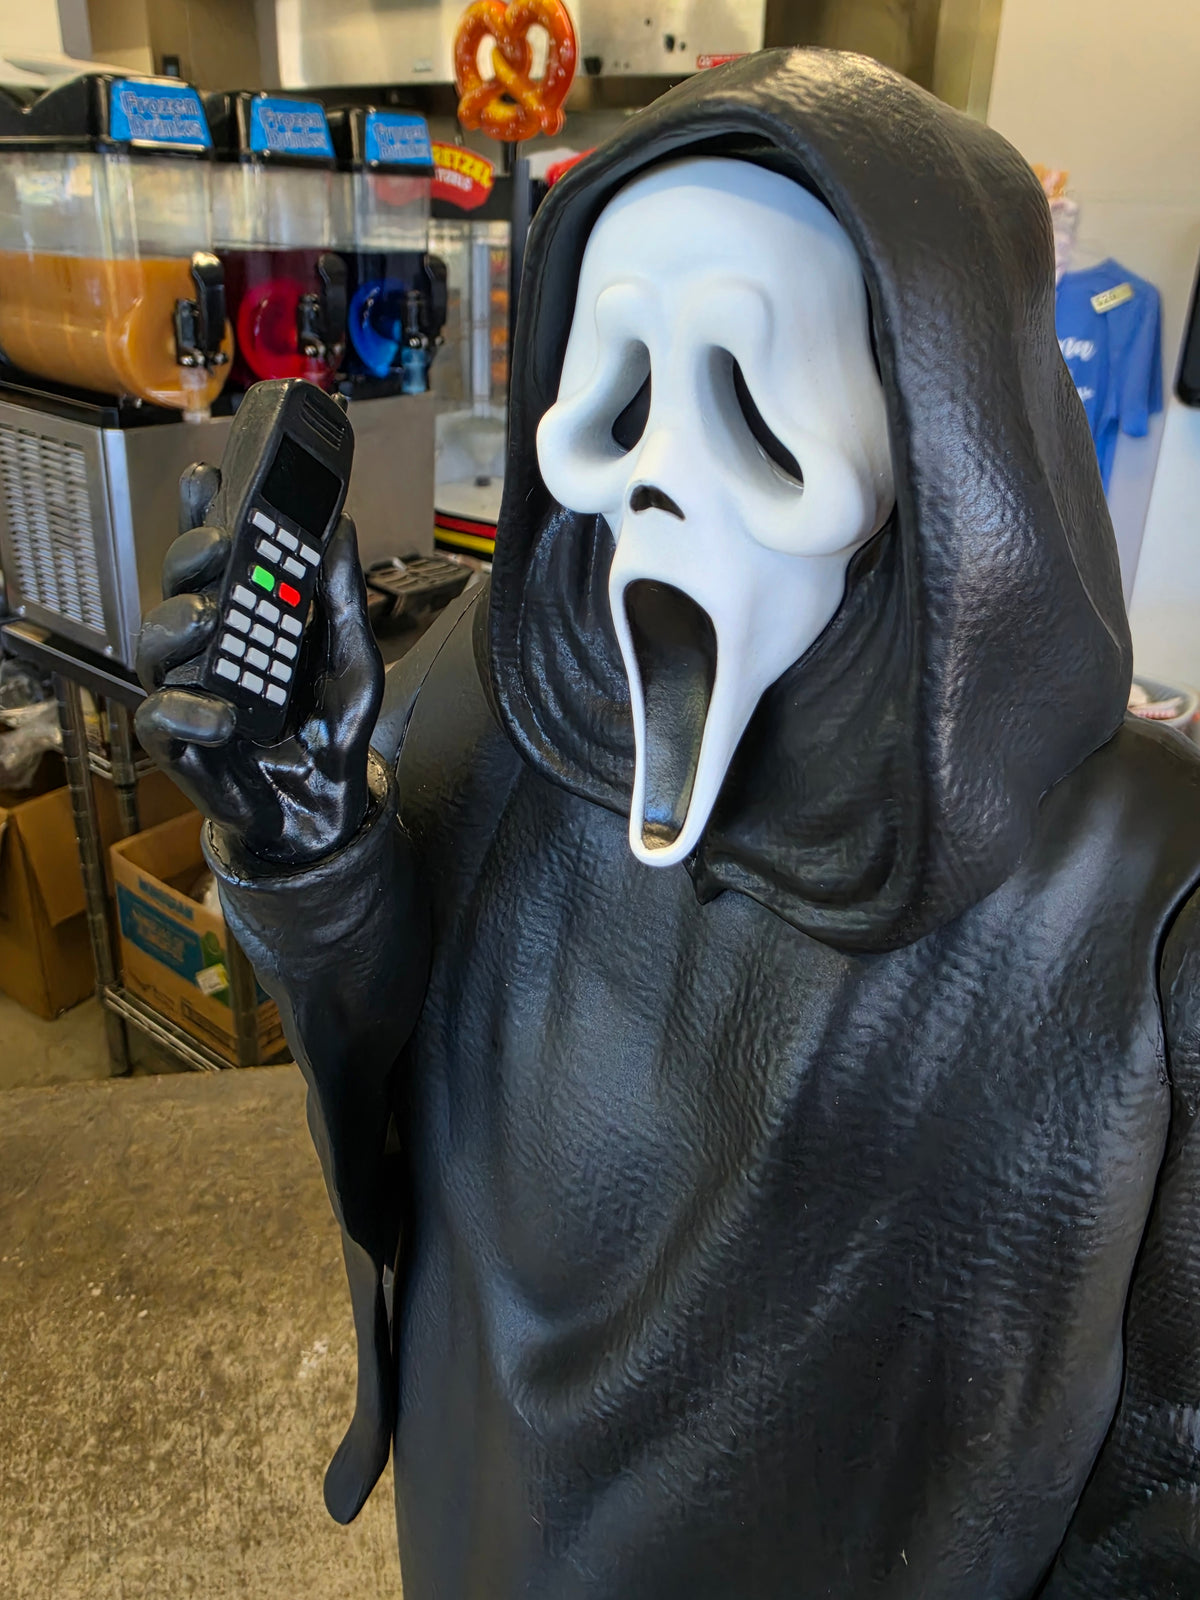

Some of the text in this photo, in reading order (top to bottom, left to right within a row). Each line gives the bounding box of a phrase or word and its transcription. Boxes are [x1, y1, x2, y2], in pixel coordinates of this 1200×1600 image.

[120, 89, 199, 115] Frozen
[258, 107, 323, 130] Frozen
[432, 145, 492, 189] RETZEL
